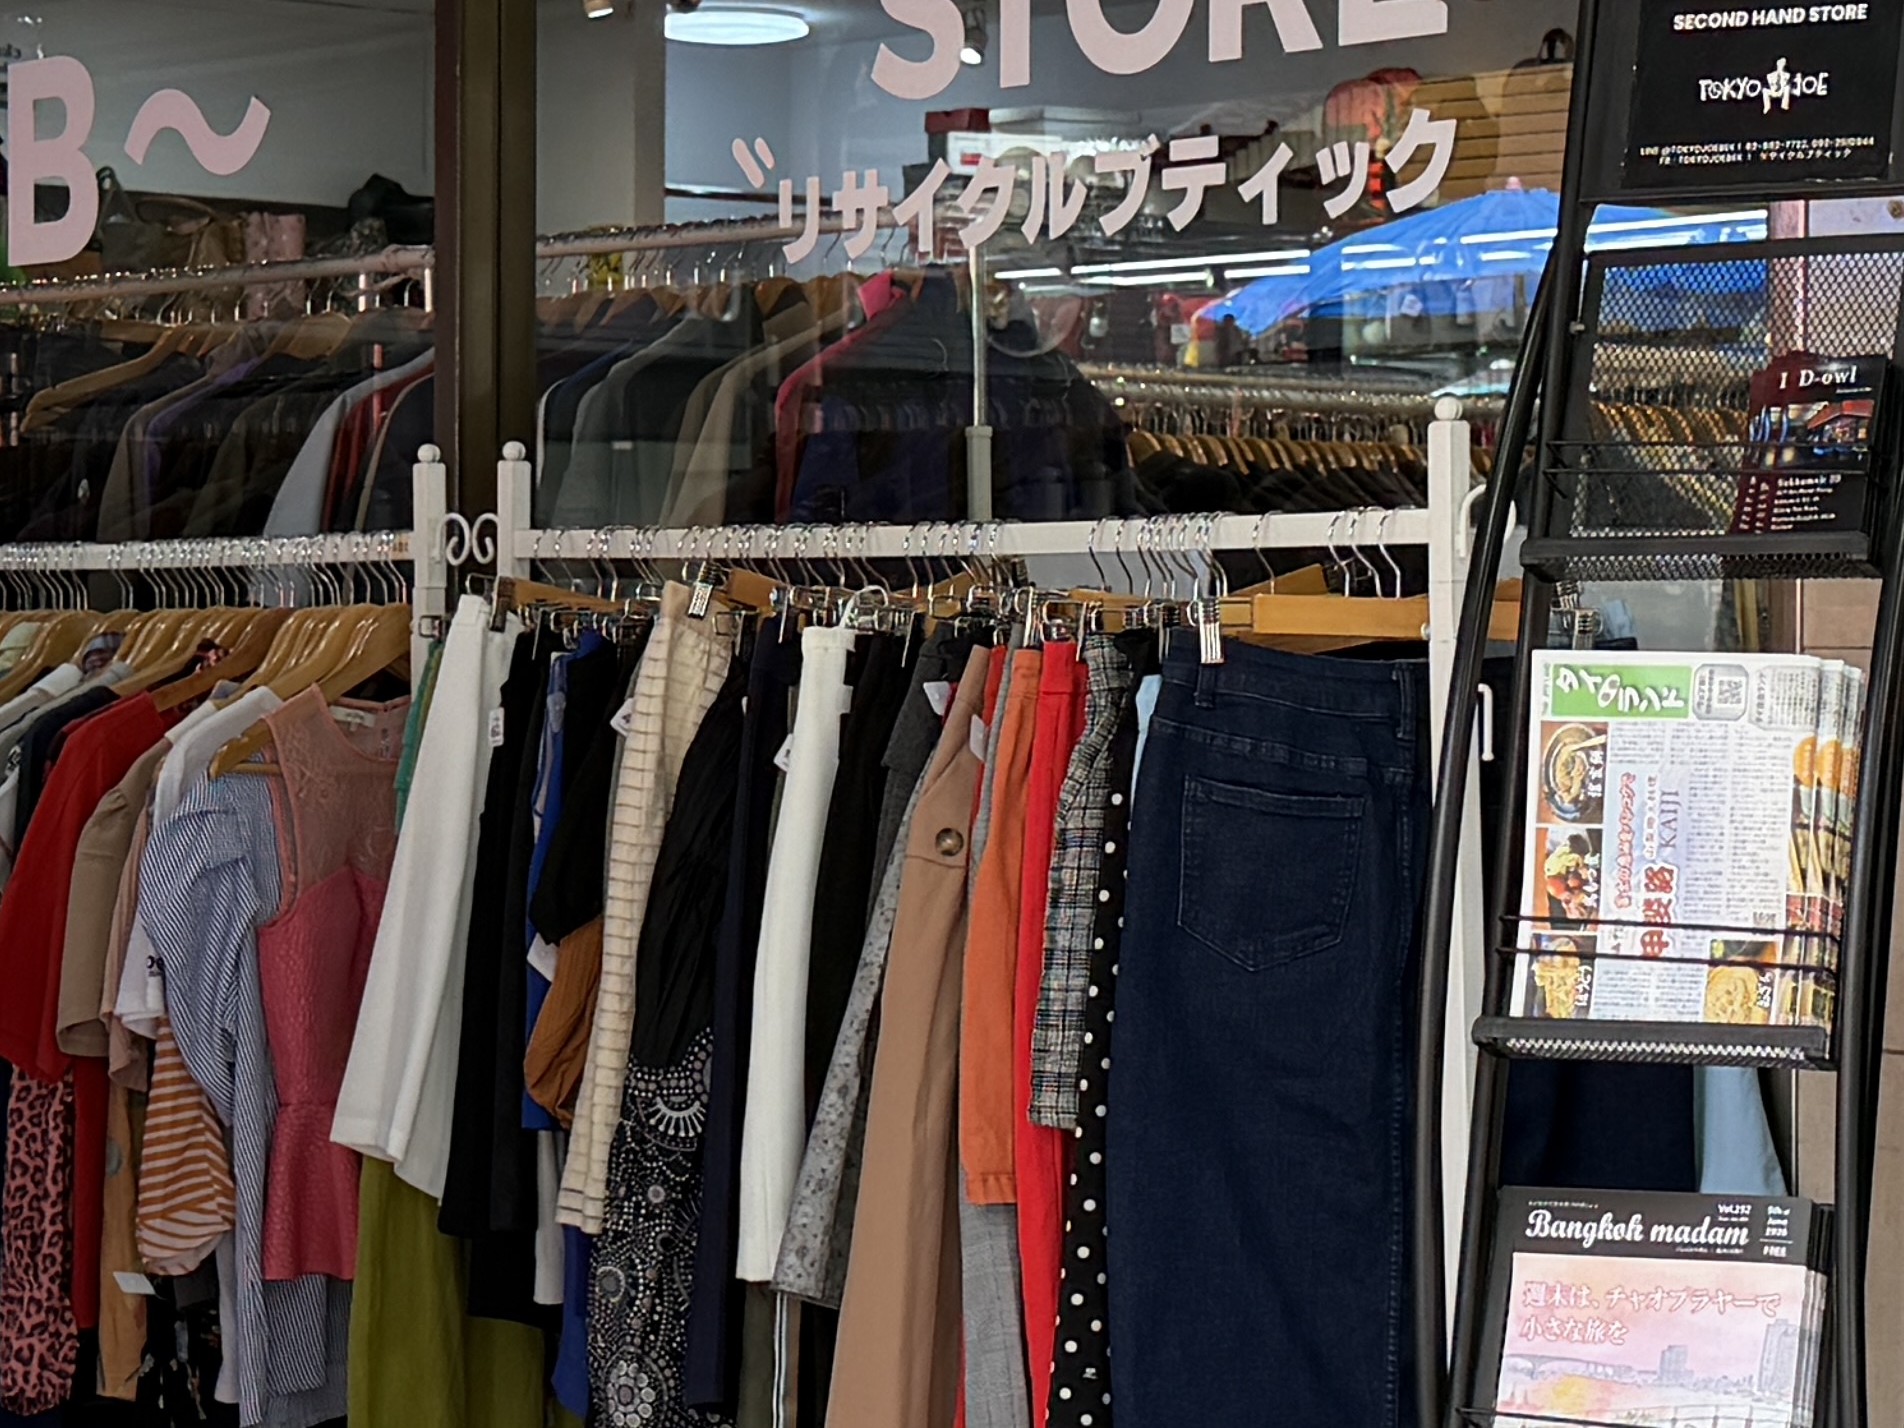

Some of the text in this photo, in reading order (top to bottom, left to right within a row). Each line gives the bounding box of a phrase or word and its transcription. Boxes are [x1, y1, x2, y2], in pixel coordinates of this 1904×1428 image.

[1672, 3, 1869, 31] SECOND HAND STORE
[1698, 75, 1763, 102] TOKYO
[1659, 788, 1681, 849] KAIJI
[1524, 1208, 1750, 1249] Bangkok madam
